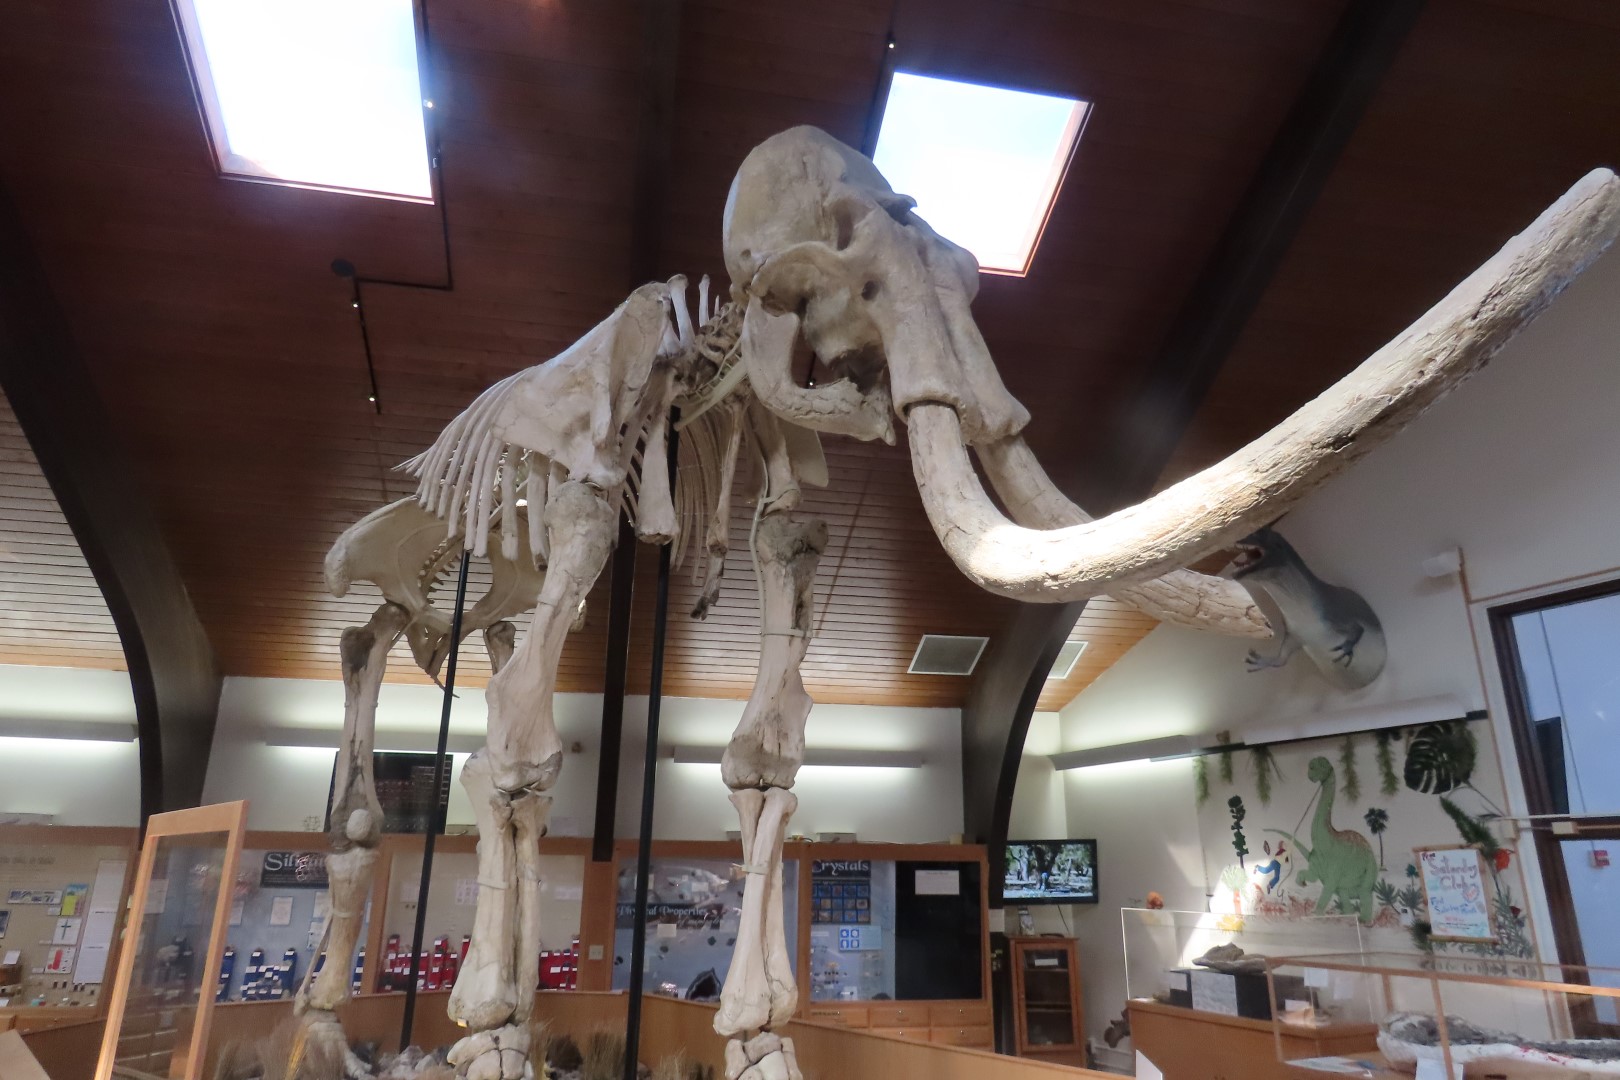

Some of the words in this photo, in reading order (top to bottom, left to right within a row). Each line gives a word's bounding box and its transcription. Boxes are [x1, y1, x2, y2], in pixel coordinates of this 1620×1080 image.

[812, 858, 869, 876] Crystals
[1428, 855, 1477, 879] Saturday
[1440, 874, 1468, 892] Club
